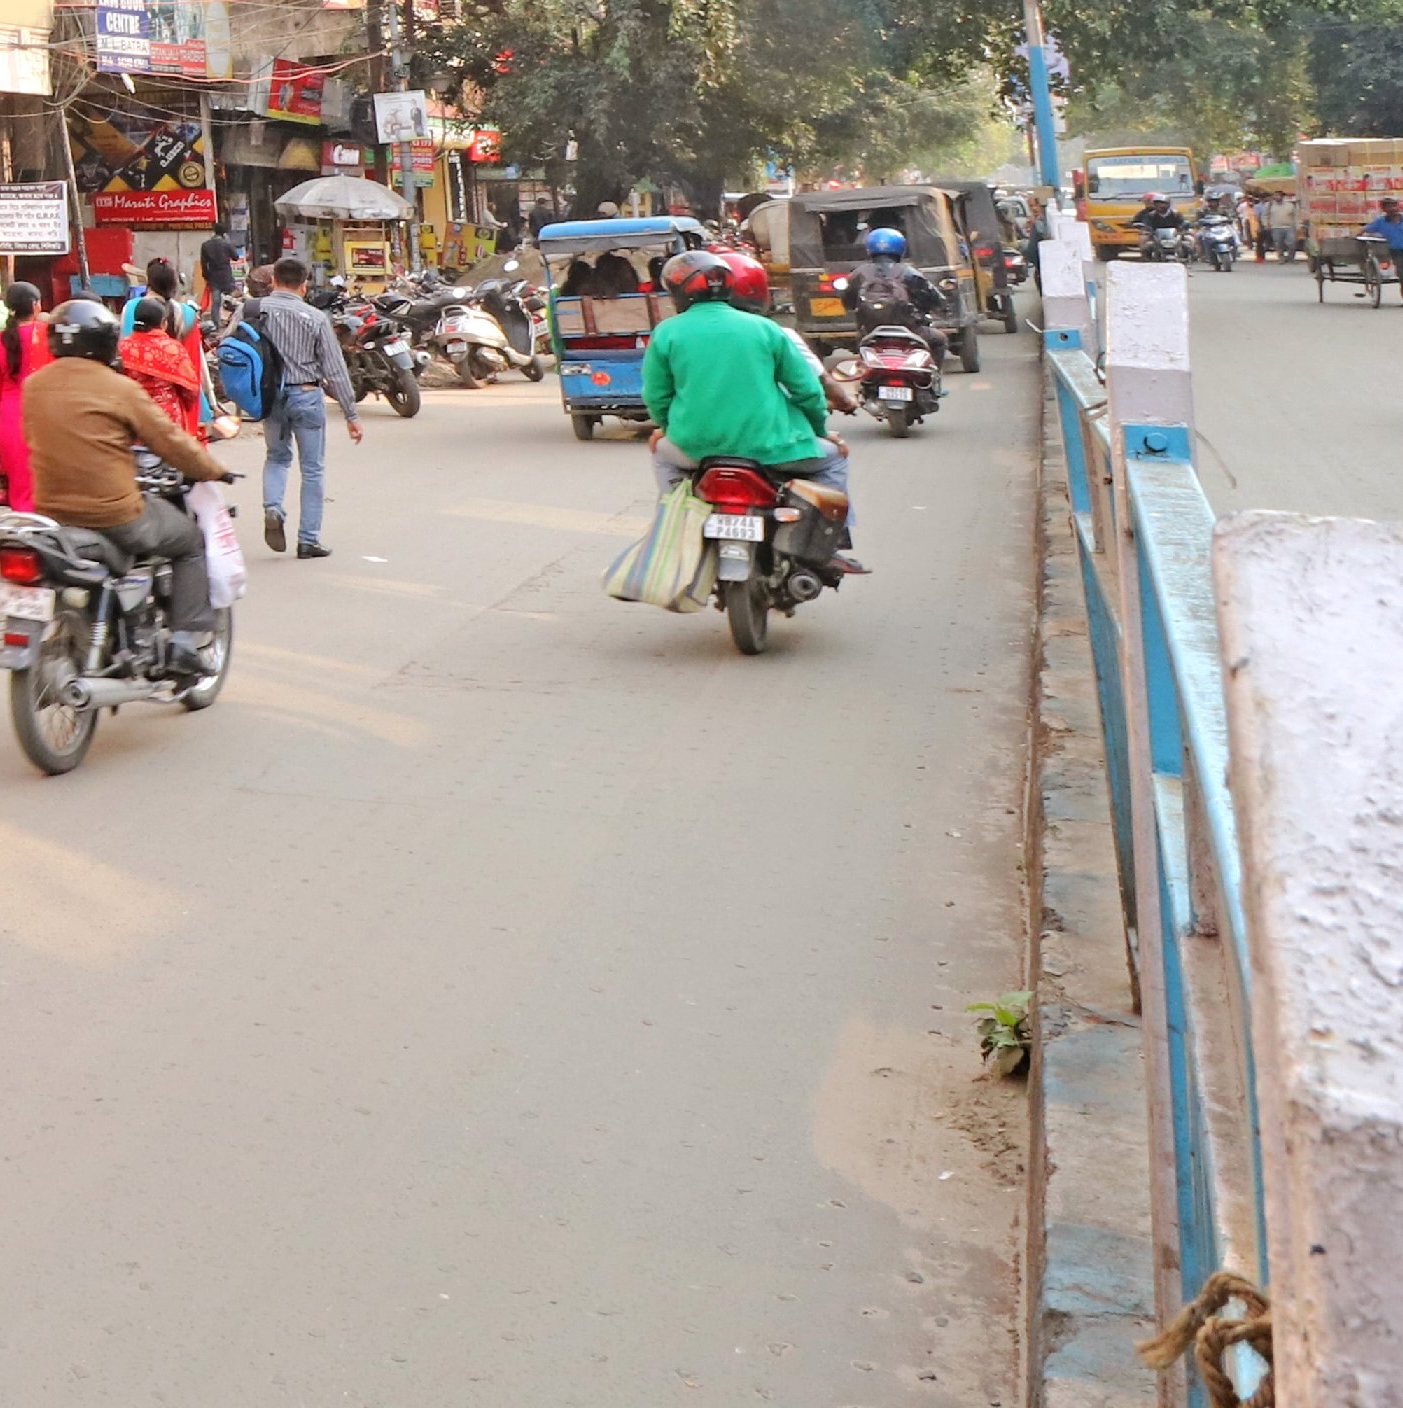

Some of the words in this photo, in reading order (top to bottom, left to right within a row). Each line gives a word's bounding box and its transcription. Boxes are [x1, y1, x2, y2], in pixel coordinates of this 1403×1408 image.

[105, 12, 140, 35] CENTRE
[114, 194, 155, 209] Maruti
[158, 192, 212, 212] Graphics
